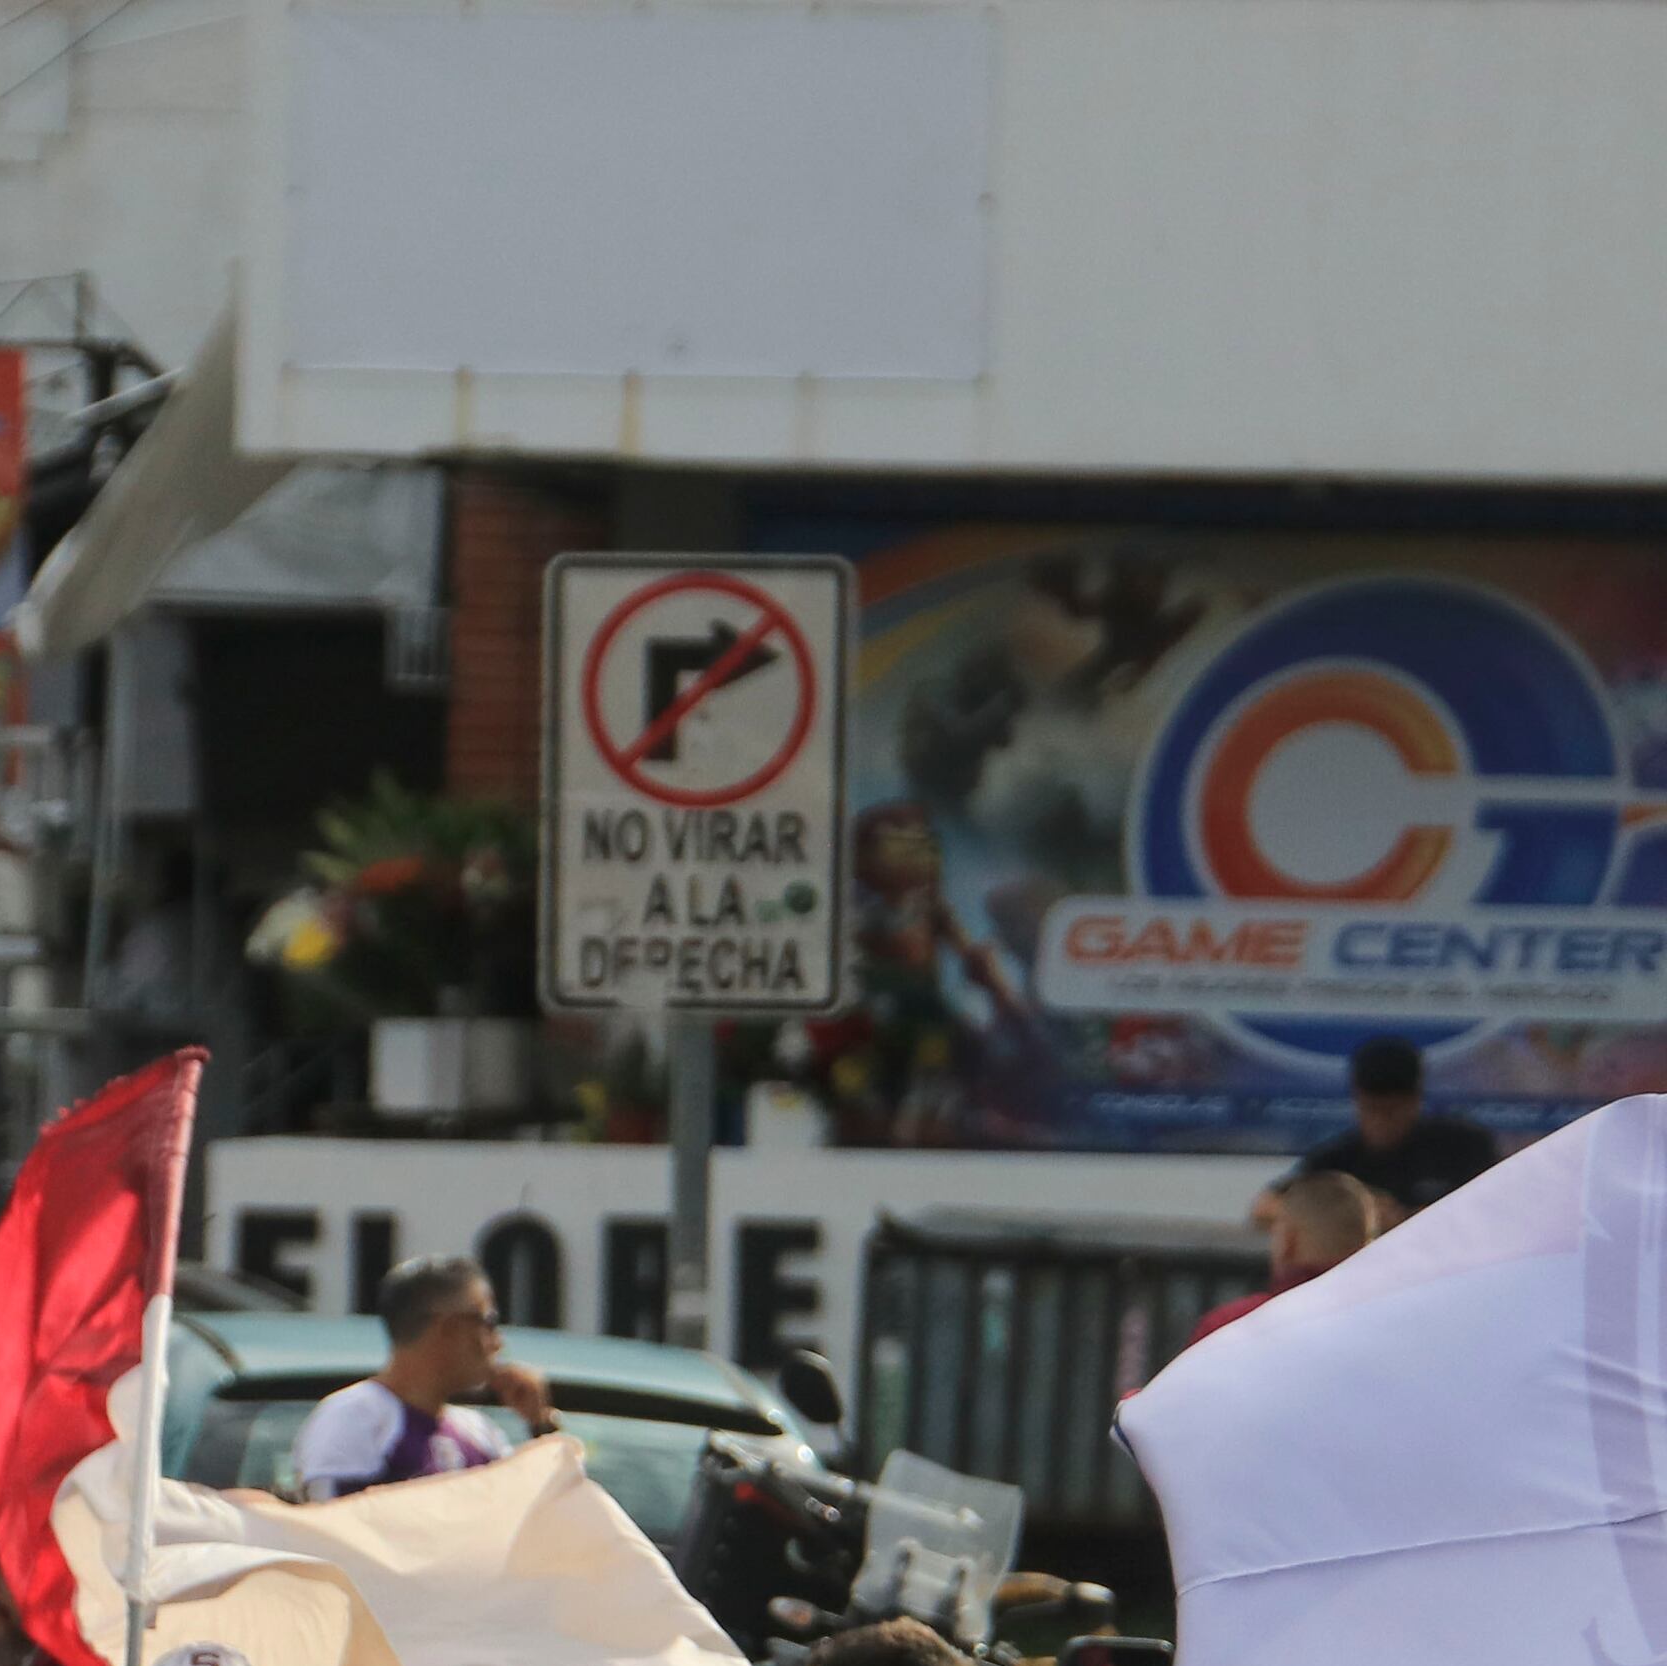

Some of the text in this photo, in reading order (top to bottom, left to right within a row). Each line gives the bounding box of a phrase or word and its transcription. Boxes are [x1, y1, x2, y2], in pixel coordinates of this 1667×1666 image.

[584, 808, 808, 865] NO VIRAR
[643, 872, 747, 927] A LA
[1066, 916, 1666, 972] GAME CENTER
